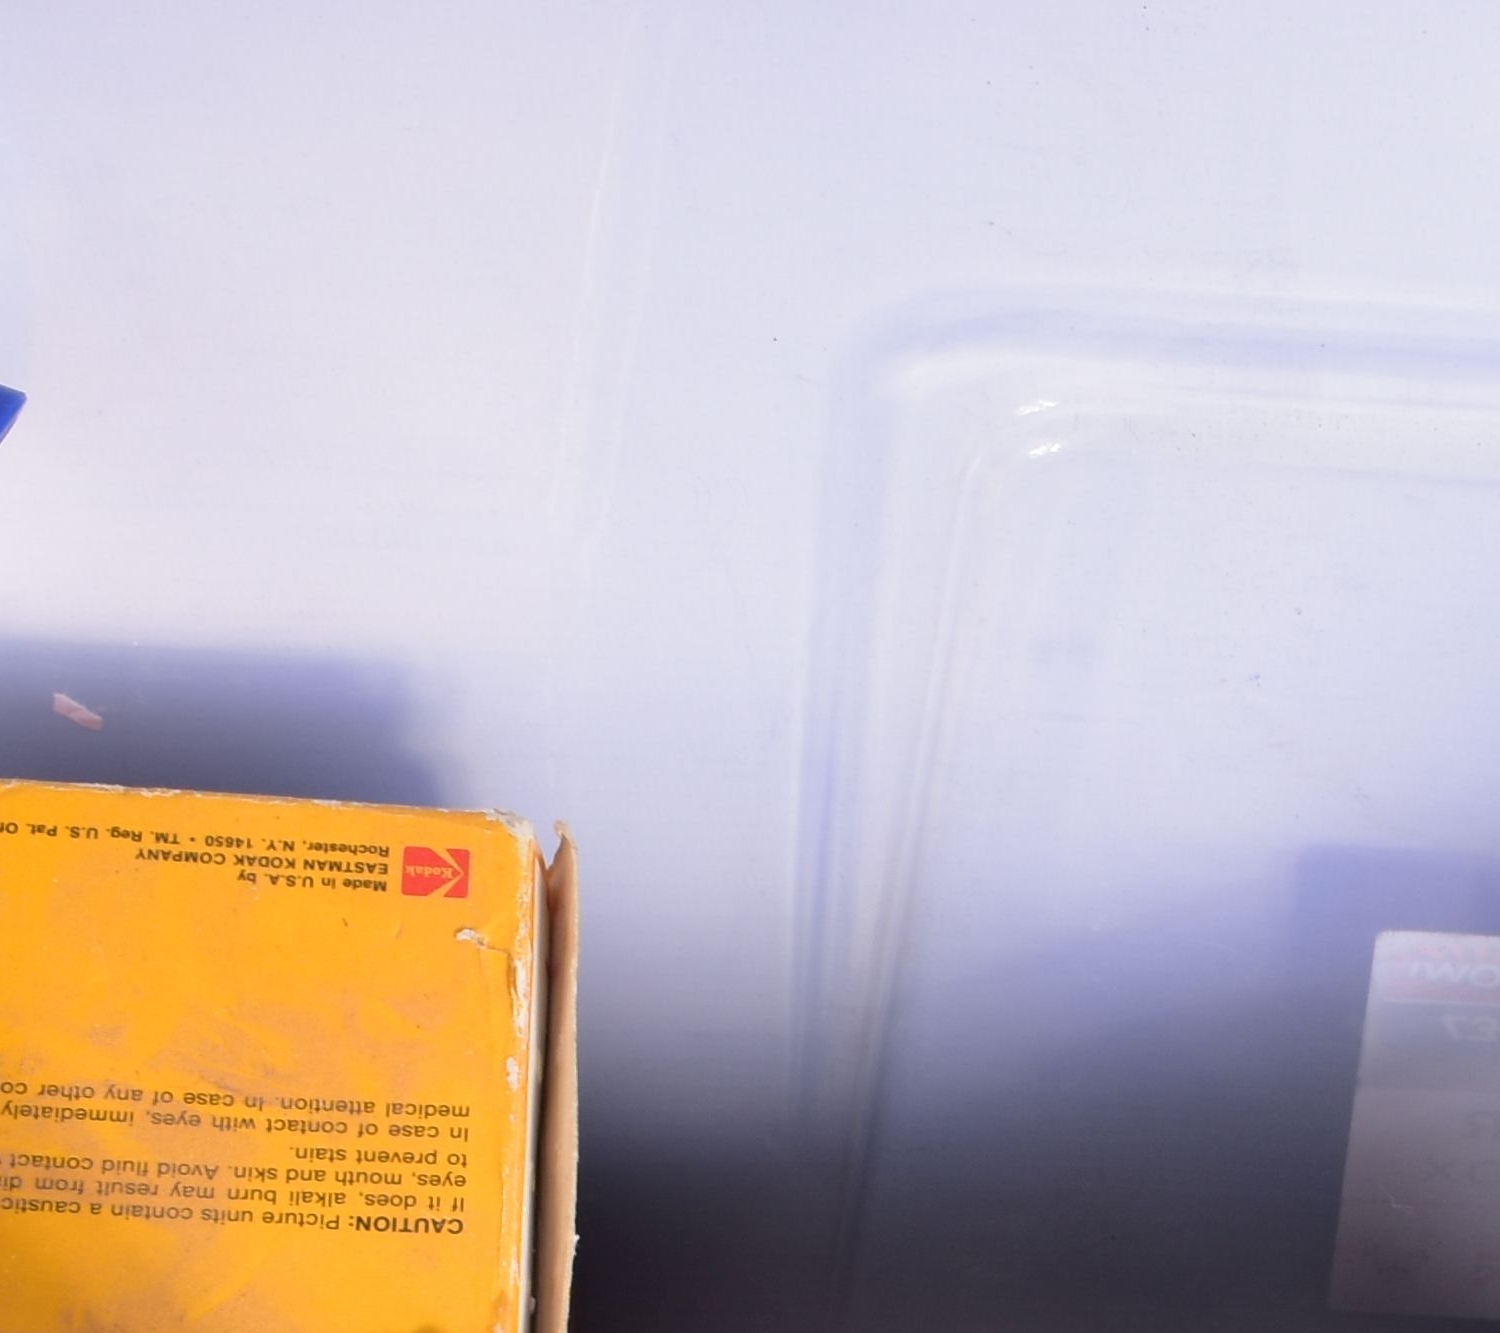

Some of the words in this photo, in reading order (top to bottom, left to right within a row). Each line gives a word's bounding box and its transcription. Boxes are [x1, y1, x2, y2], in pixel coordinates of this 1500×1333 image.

[24, 822, 60, 839] Pat.
[63, 824, 100, 841] U.S.
[104, 824, 144, 844] Reg.
[148, 830, 182, 847] TM.
[202, 833, 255, 851] 14650
[260, 837, 297, 854] N.Y.
[301, 838, 392, 860] Rochester,
[133, 846, 228, 867] COMPANY
[231, 852, 298, 871] KODAK
[235, 867, 259, 887] by
[301, 857, 390, 877] EASTMAN
[404, 863, 453, 880] Kodak
[262, 871, 316, 890] U.S.A.
[319, 875, 338, 891] in
[340, 876, 389, 894] Made
[35, 1082, 97, 1103] other
[102, 1082, 145, 1103] any
[150, 1089, 176, 1108] of
[182, 1090, 235, 1108] case
[242, 1094, 267, 1113] In
[273, 1095, 377, 1117] attention.
[384, 1101, 471, 1121] medical
[144, 1108, 203, 1129] eyes,
[209, 1114, 258, 1134] with
[264, 1116, 350, 1136] contact
[355, 1121, 380, 1140] of
[386, 1122, 441, 1140] case
[448, 1125, 470, 1144] In
[7, 1152, 96, 1172] contact
[288, 1145, 349, 1165] stain.
[354, 1148, 439, 1167] prevent
[445, 1151, 469, 1173] to
[99, 1157, 150, 1178] fluid
[155, 1160, 221, 1182] Avoid
[227, 1164, 280, 1184] skin.
[284, 1166, 328, 1185] and
[33, 1176, 86, 1197] from
[94, 1179, 160, 1198] result
[333, 1169, 404, 1188] mouth
[410, 1169, 468, 1189] eyes,
[168, 1179, 216, 1201] may
[225, 1186, 279, 1207] burn
[287, 1189, 348, 1209] alkali
[0, 1195, 83, 1215] caustic
[88, 1201, 104, 1217] a
[357, 1190, 419, 1212] does,
[426, 1194, 443, 1213] it
[449, 1195, 466, 1214] If
[109, 1202, 195, 1222] contain
[199, 1207, 255, 1226] units
[260, 1209, 342, 1232] Picture
[346, 1214, 466, 1237] CAUTION:
